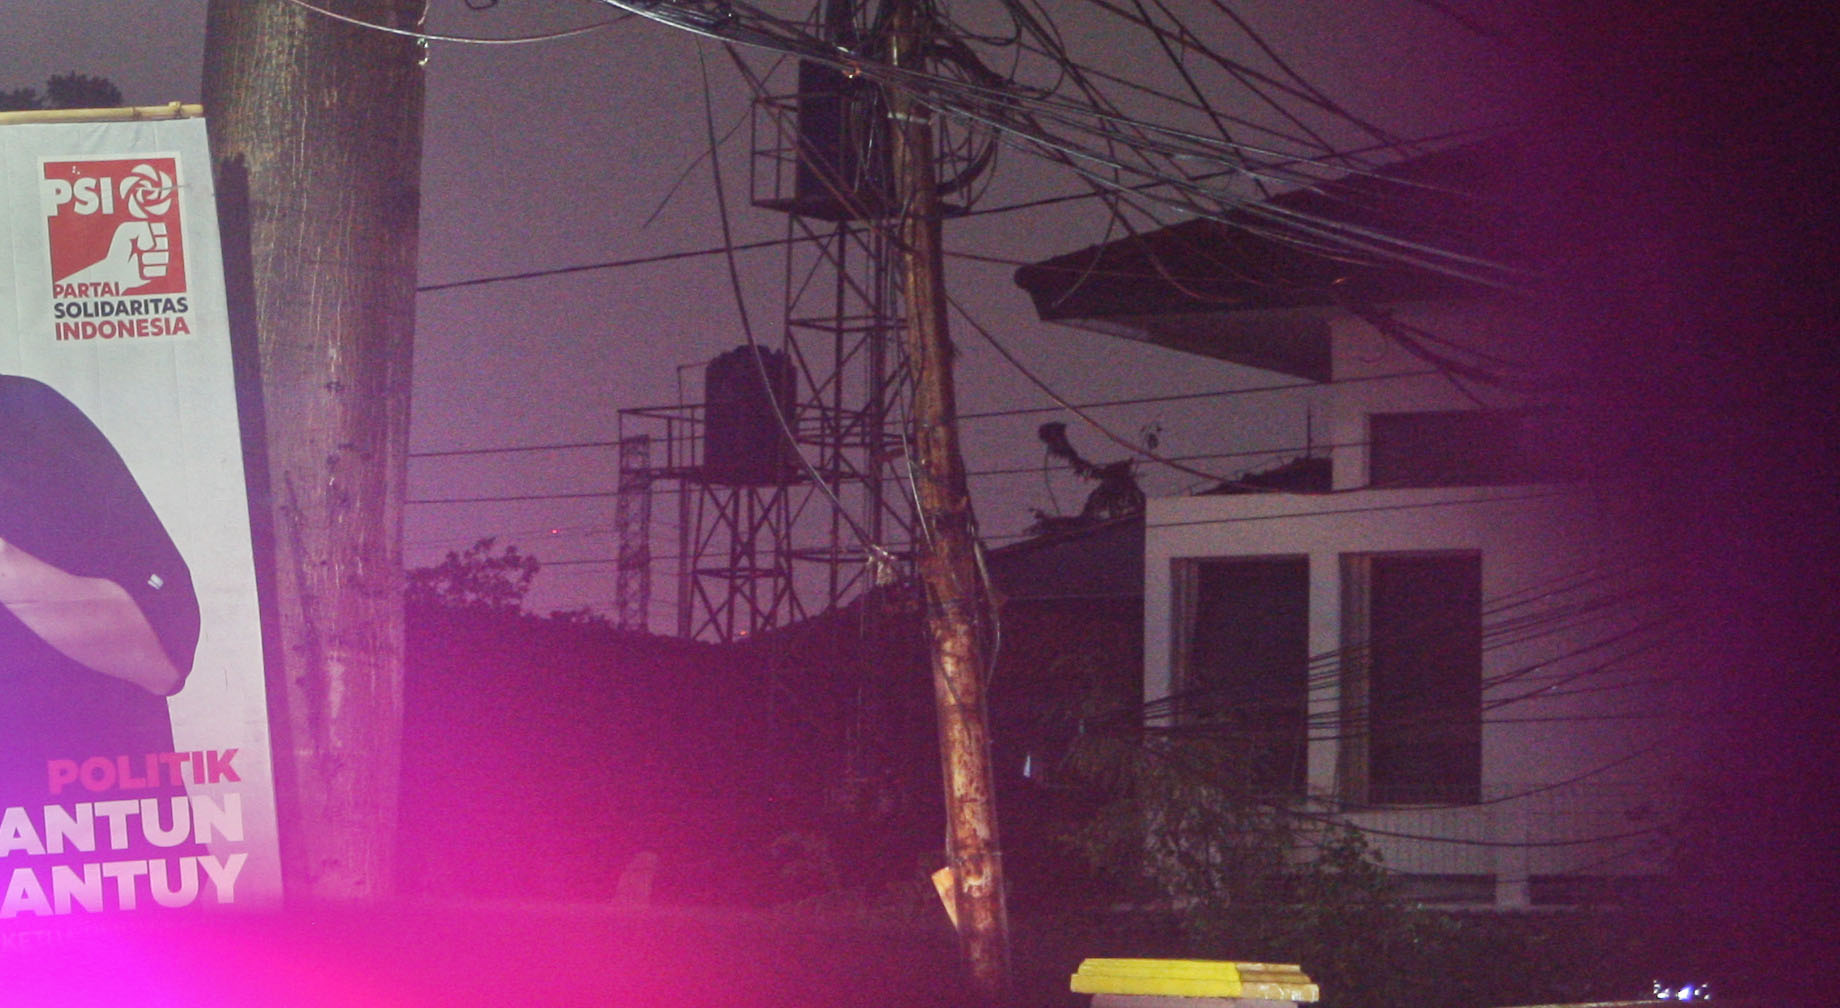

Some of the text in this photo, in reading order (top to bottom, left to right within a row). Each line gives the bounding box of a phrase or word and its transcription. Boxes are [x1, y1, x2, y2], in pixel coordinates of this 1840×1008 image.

[44, 176, 115, 217] PSI
[53, 282, 121, 299] PARTAI
[54, 297, 189, 319] SOLIDARITAS
[55, 317, 190, 340] INDONESIA
[47, 748, 240, 794] POLITIK
